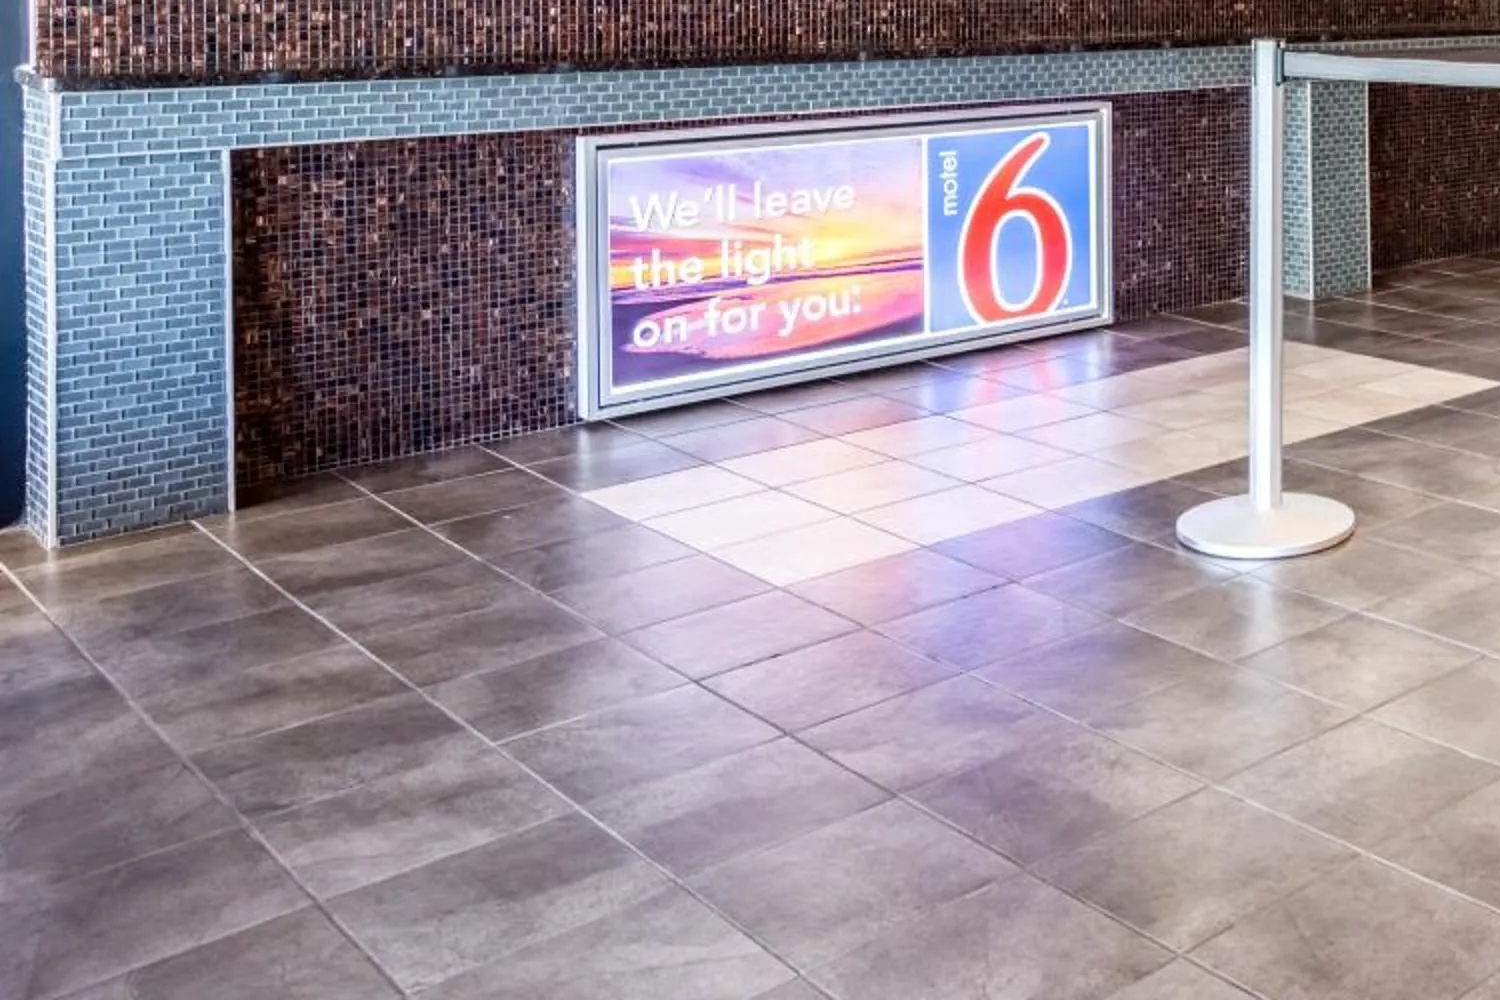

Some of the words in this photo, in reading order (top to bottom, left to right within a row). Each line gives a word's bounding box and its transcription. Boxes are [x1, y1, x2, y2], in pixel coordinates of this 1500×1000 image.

[628, 183, 737, 232] We'll
[754, 180, 856, 219] leave
[939, 150, 959, 217] motel
[957, 131, 1073, 325] 6
[630, 248, 705, 291] the
[720, 233, 816, 286] light
[632, 314, 689, 348] on
[703, 296, 768, 338] for
